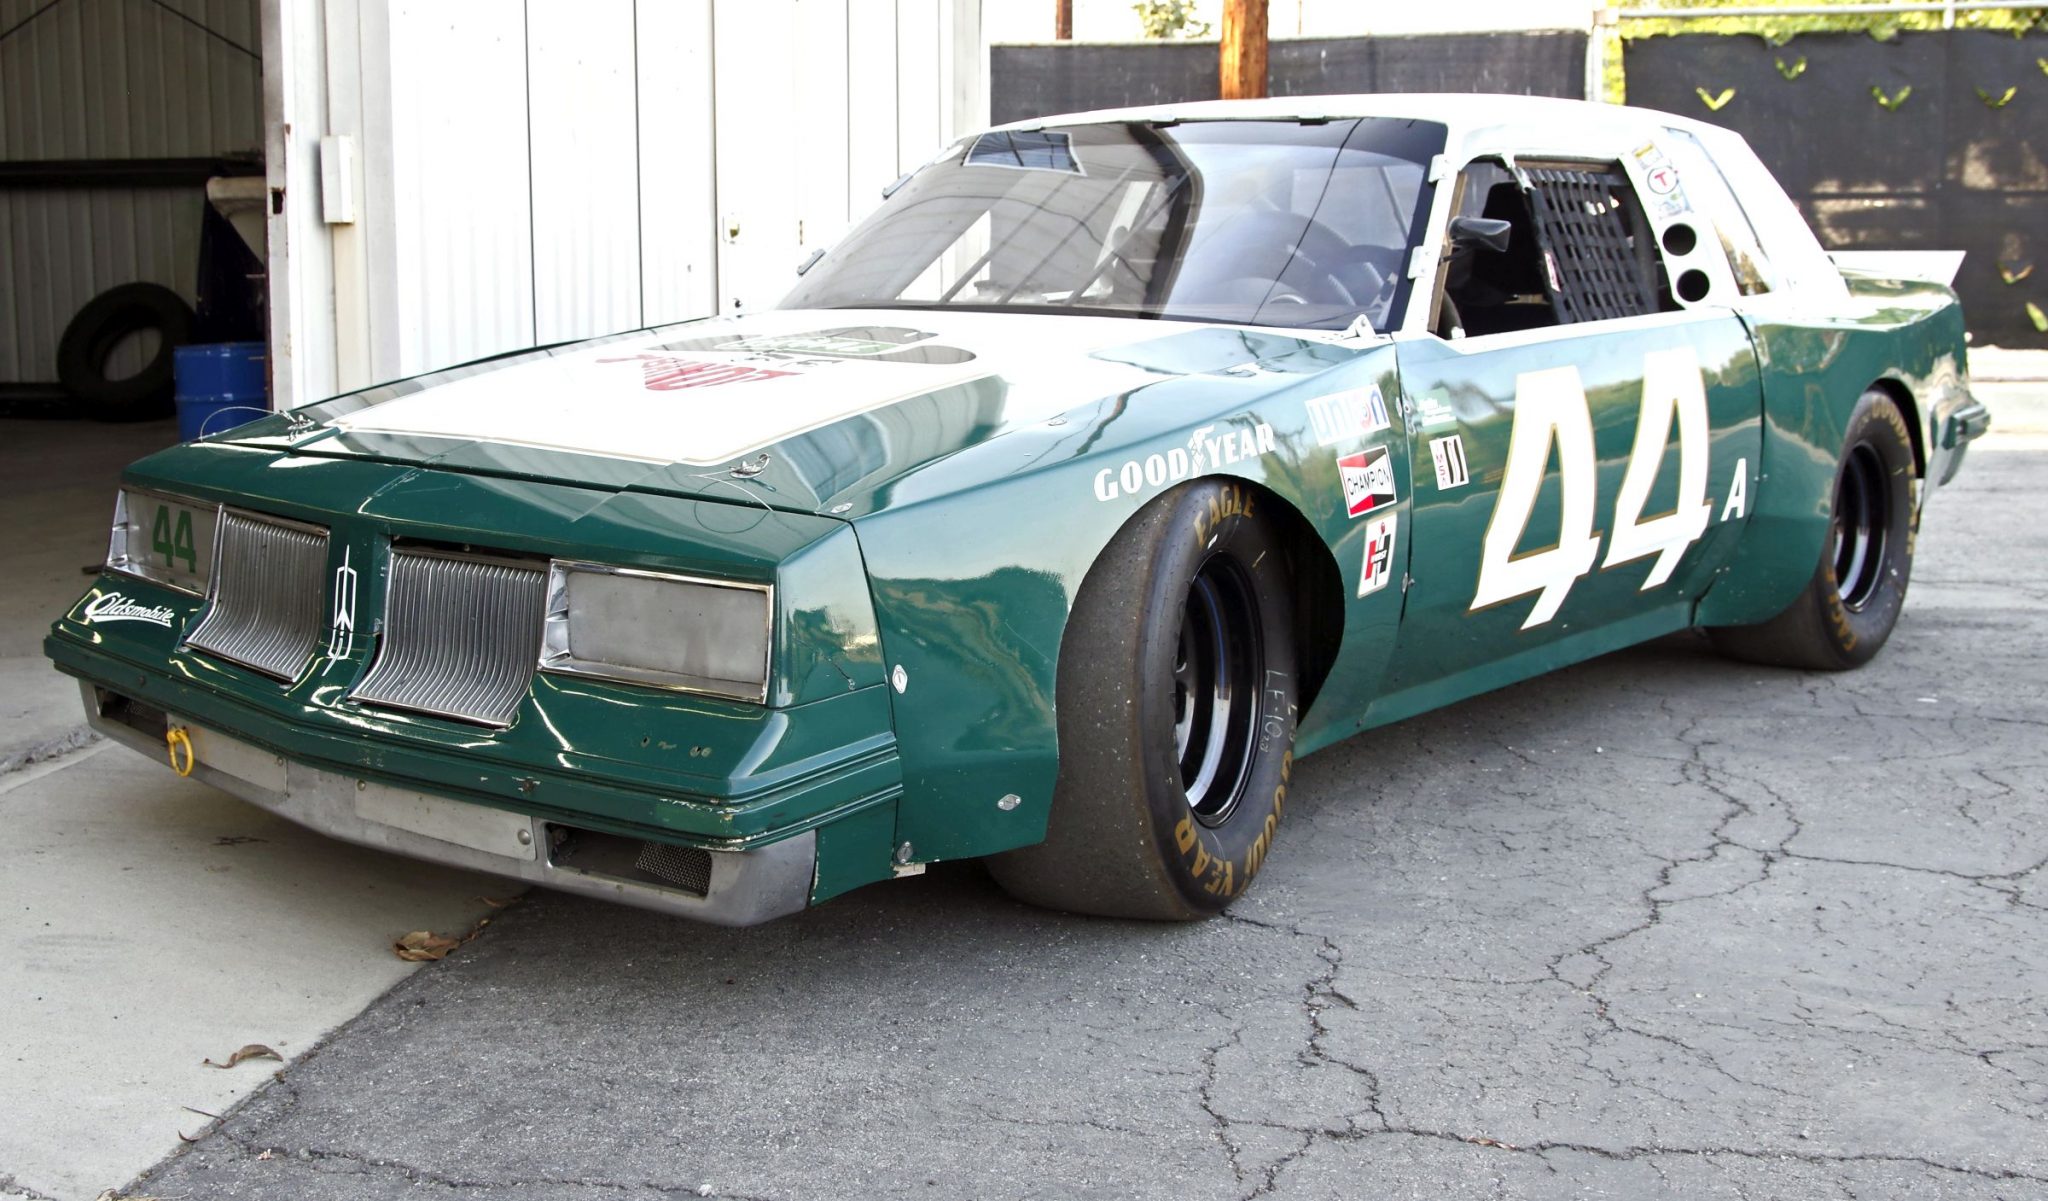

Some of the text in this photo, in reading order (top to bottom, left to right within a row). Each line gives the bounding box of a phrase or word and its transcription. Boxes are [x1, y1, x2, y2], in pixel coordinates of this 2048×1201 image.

[1308, 389, 1388, 439] union
[1346, 467, 1390, 496] CHAMPION
[1466, 346, 1712, 631] 44
[1720, 458, 1747, 522] A
[152, 504, 197, 574] 44
[1193, 483, 1256, 549] EAGLE
[84, 591, 175, 628] Oldsmobile
